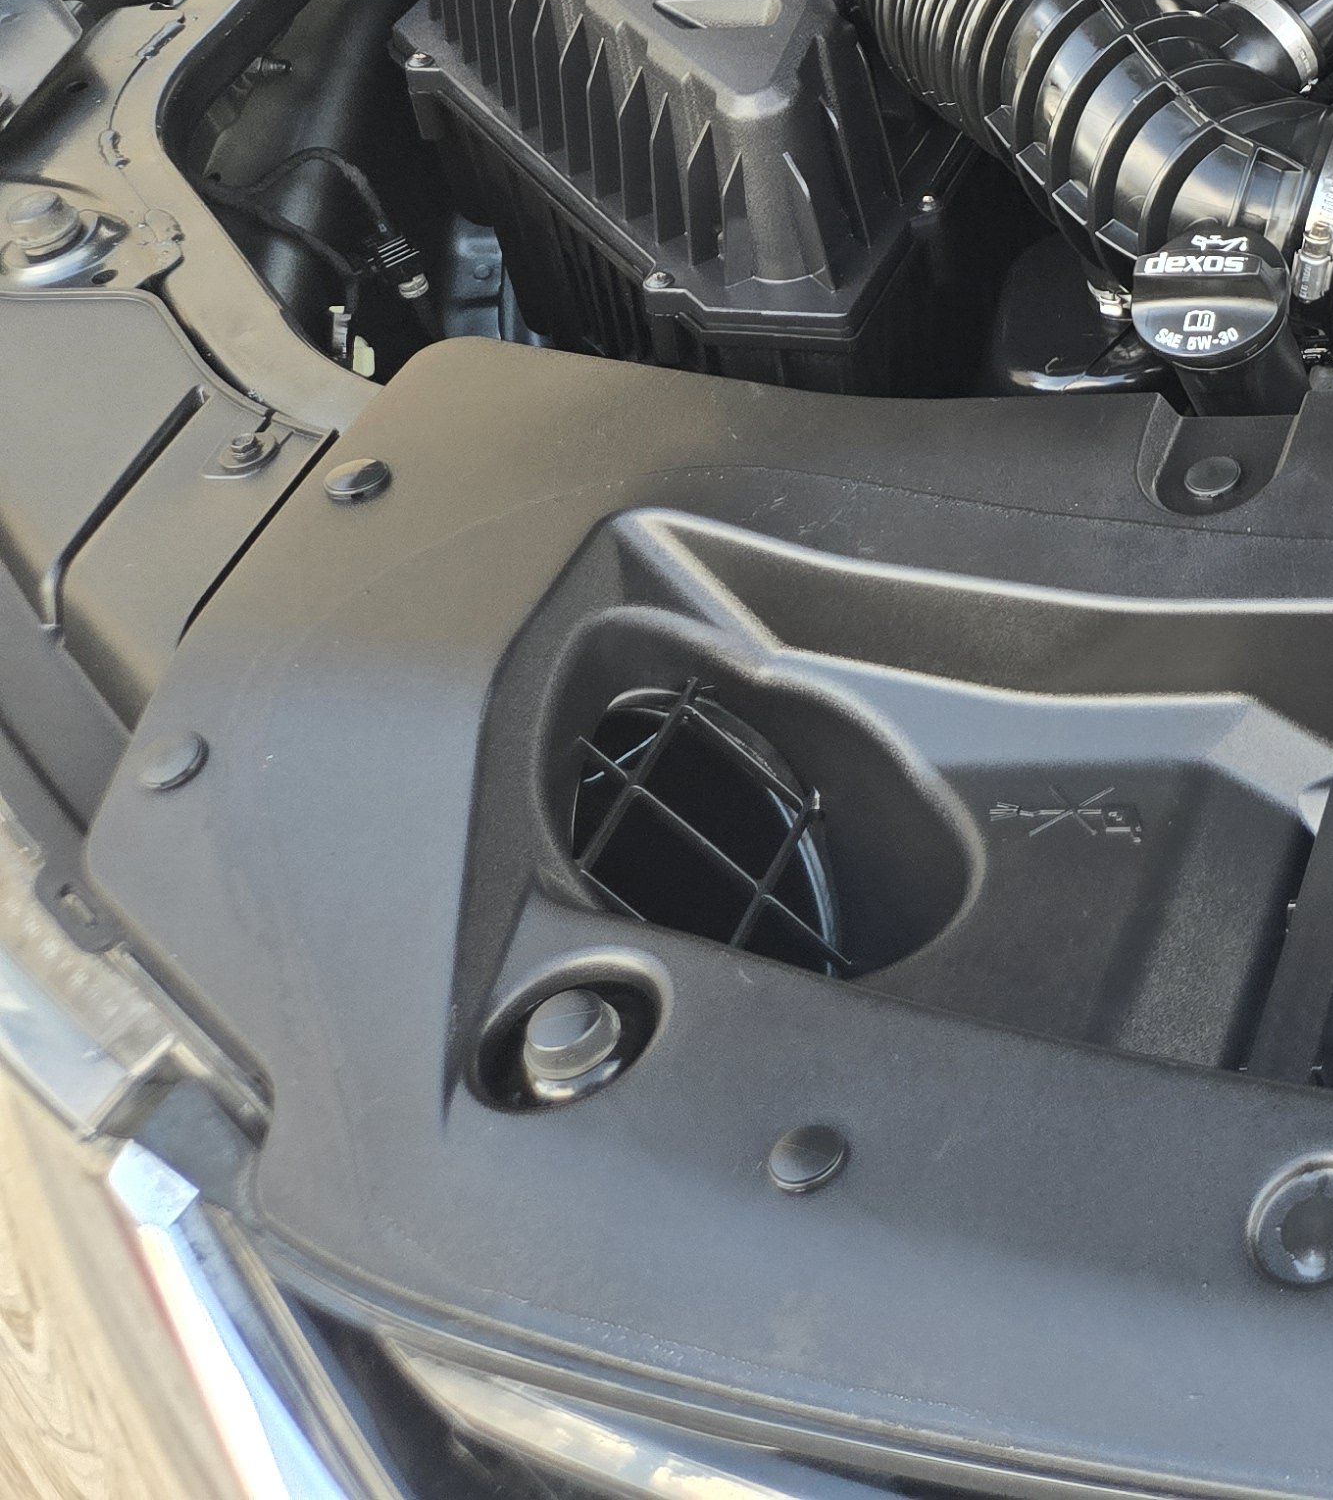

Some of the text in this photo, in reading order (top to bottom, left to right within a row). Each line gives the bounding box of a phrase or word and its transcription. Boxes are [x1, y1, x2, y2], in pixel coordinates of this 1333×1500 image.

[1144, 252, 1244, 274] dexos
[1155, 326, 1240, 350] SAE 5W-30
